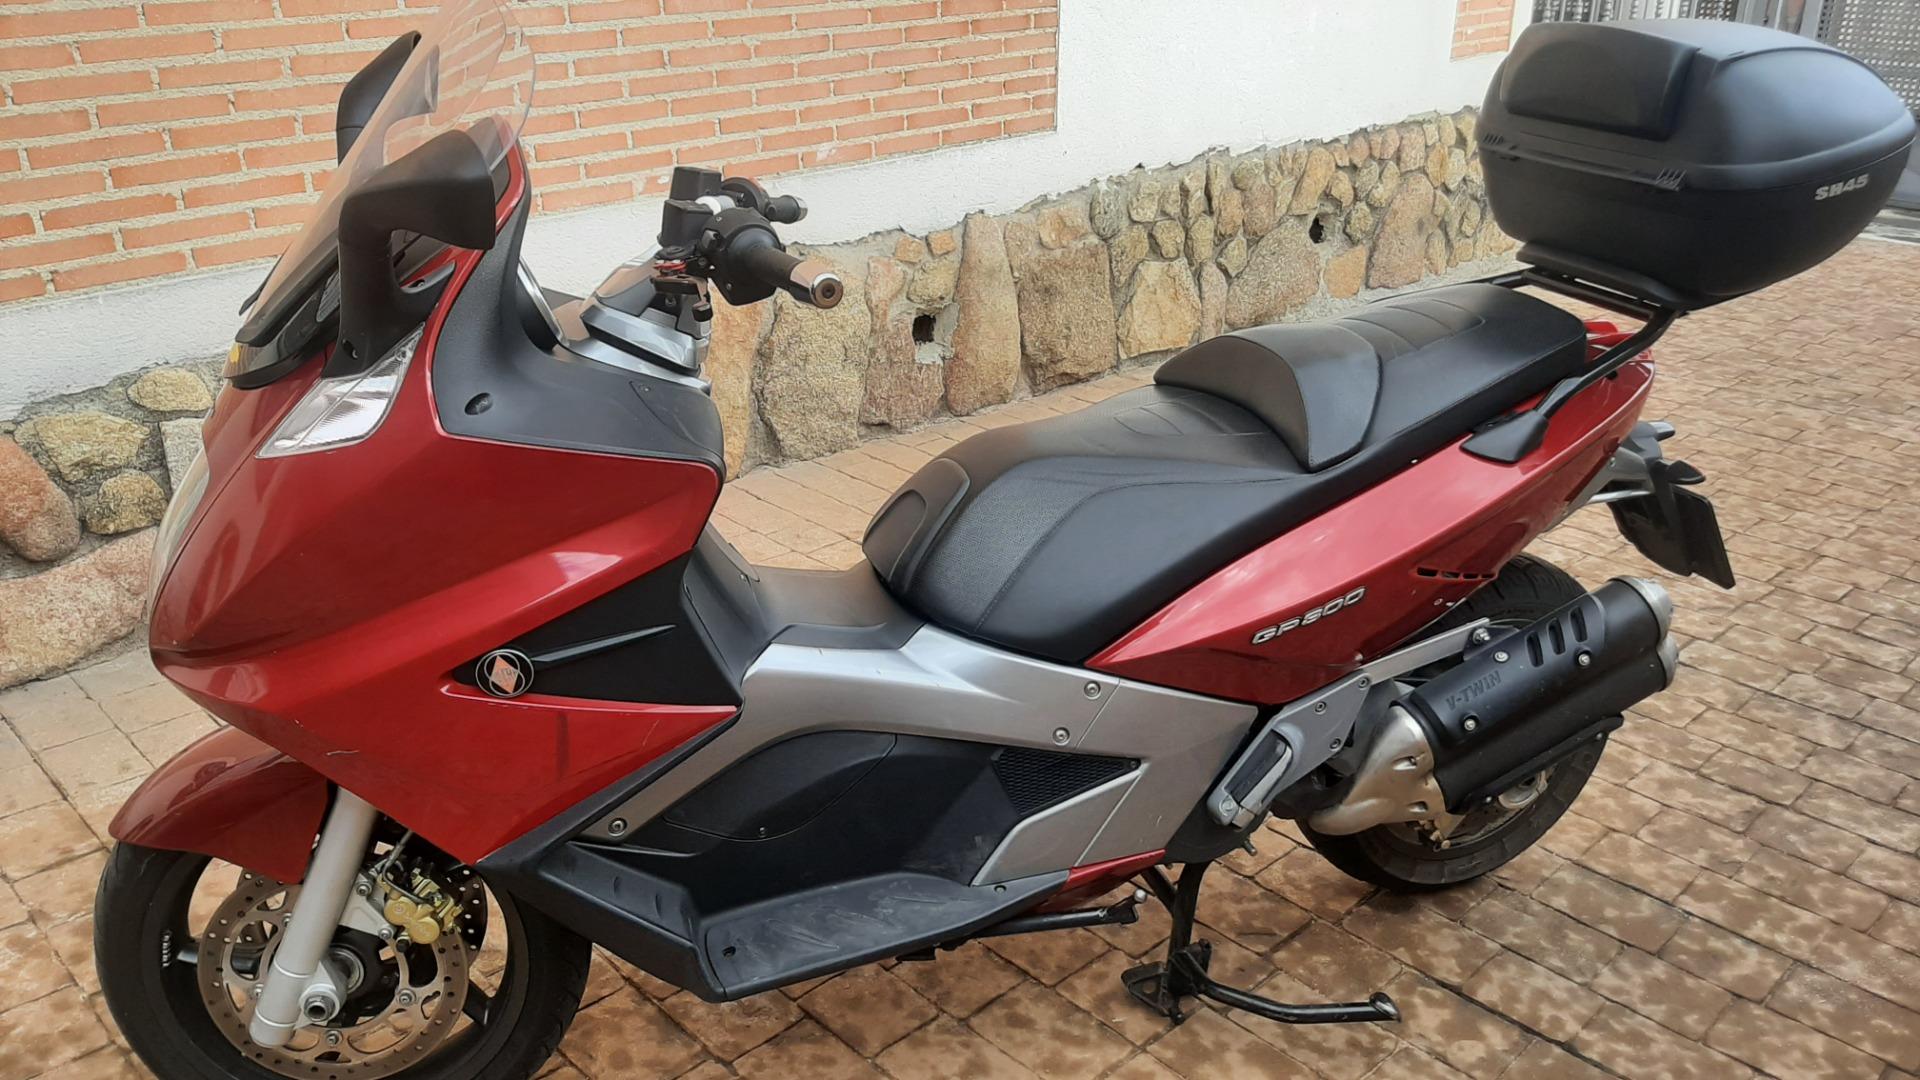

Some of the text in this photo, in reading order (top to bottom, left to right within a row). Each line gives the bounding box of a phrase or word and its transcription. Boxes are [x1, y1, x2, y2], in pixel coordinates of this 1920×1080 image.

[1814, 173, 1869, 200] SH45
[1251, 586, 1366, 644] GP800
[1445, 670, 1501, 710] V-TWIN
